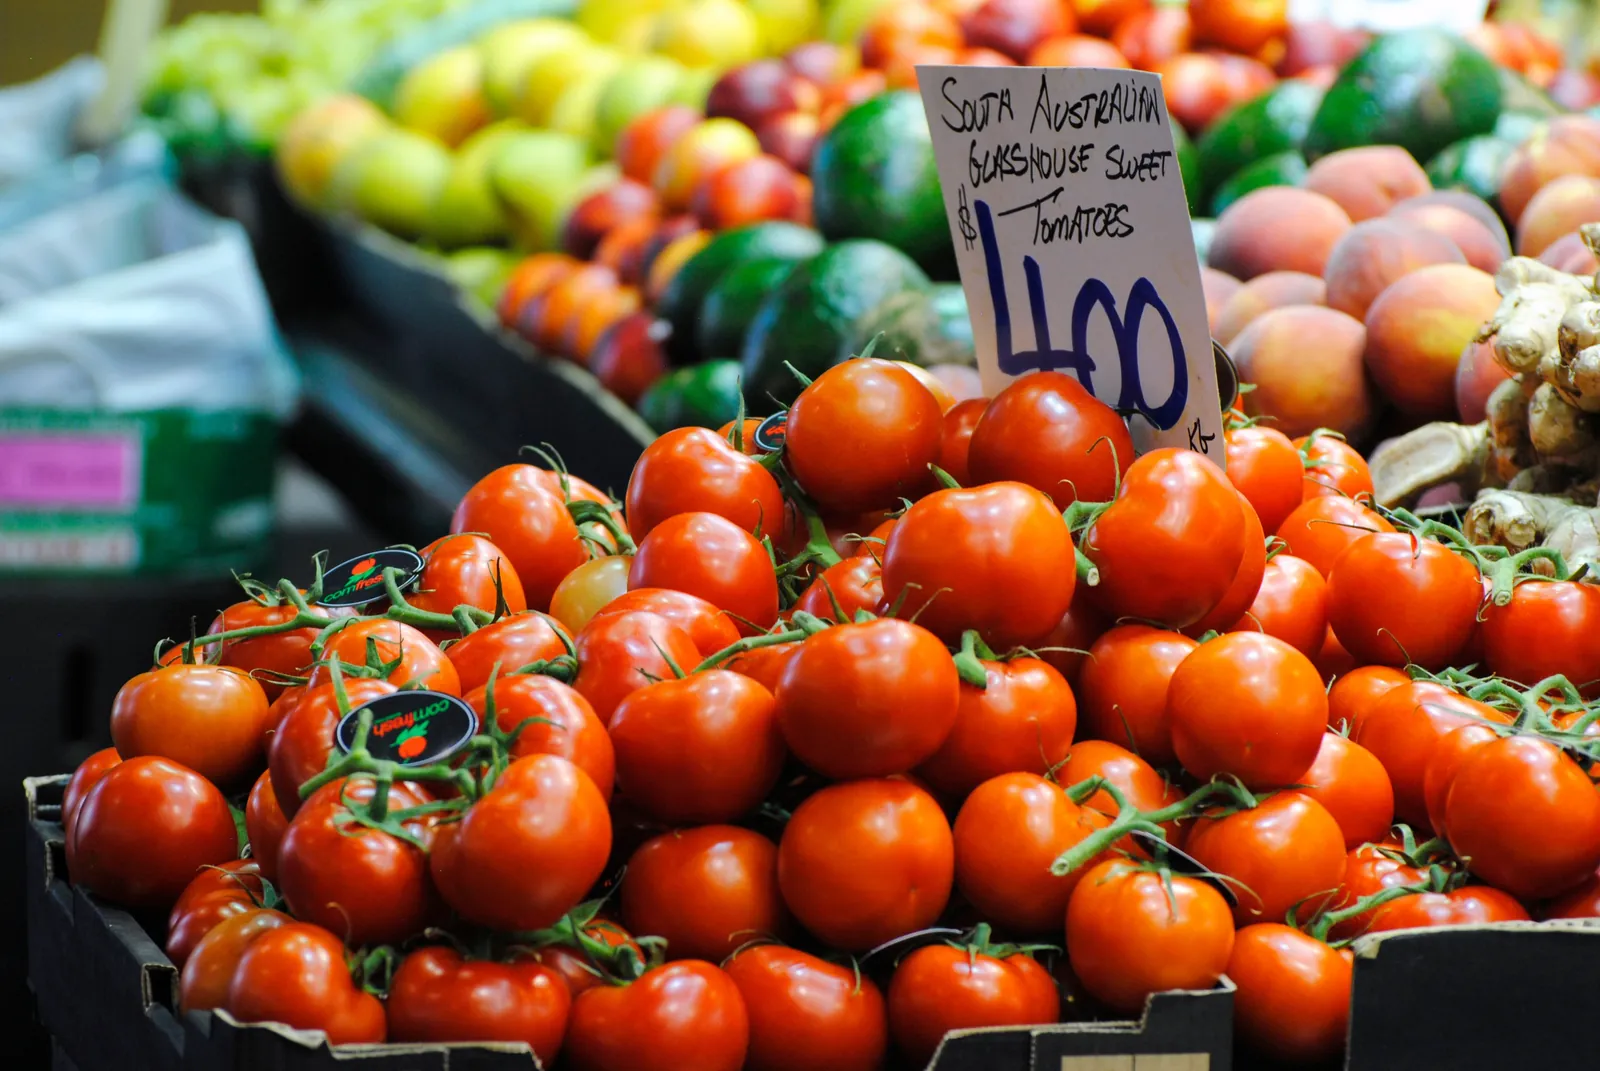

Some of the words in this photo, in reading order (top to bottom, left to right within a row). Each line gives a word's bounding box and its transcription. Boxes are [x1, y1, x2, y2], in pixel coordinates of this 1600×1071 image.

[940, 76, 1015, 133] SOUTH
[1029, 73, 1161, 134] AUSTRALIAN
[968, 139, 1095, 188] GLASSHOUSE
[1105, 144, 1173, 183] SWEET
[997, 186, 1135, 246] TOMATOES
[323, 573, 385, 604] comfres
